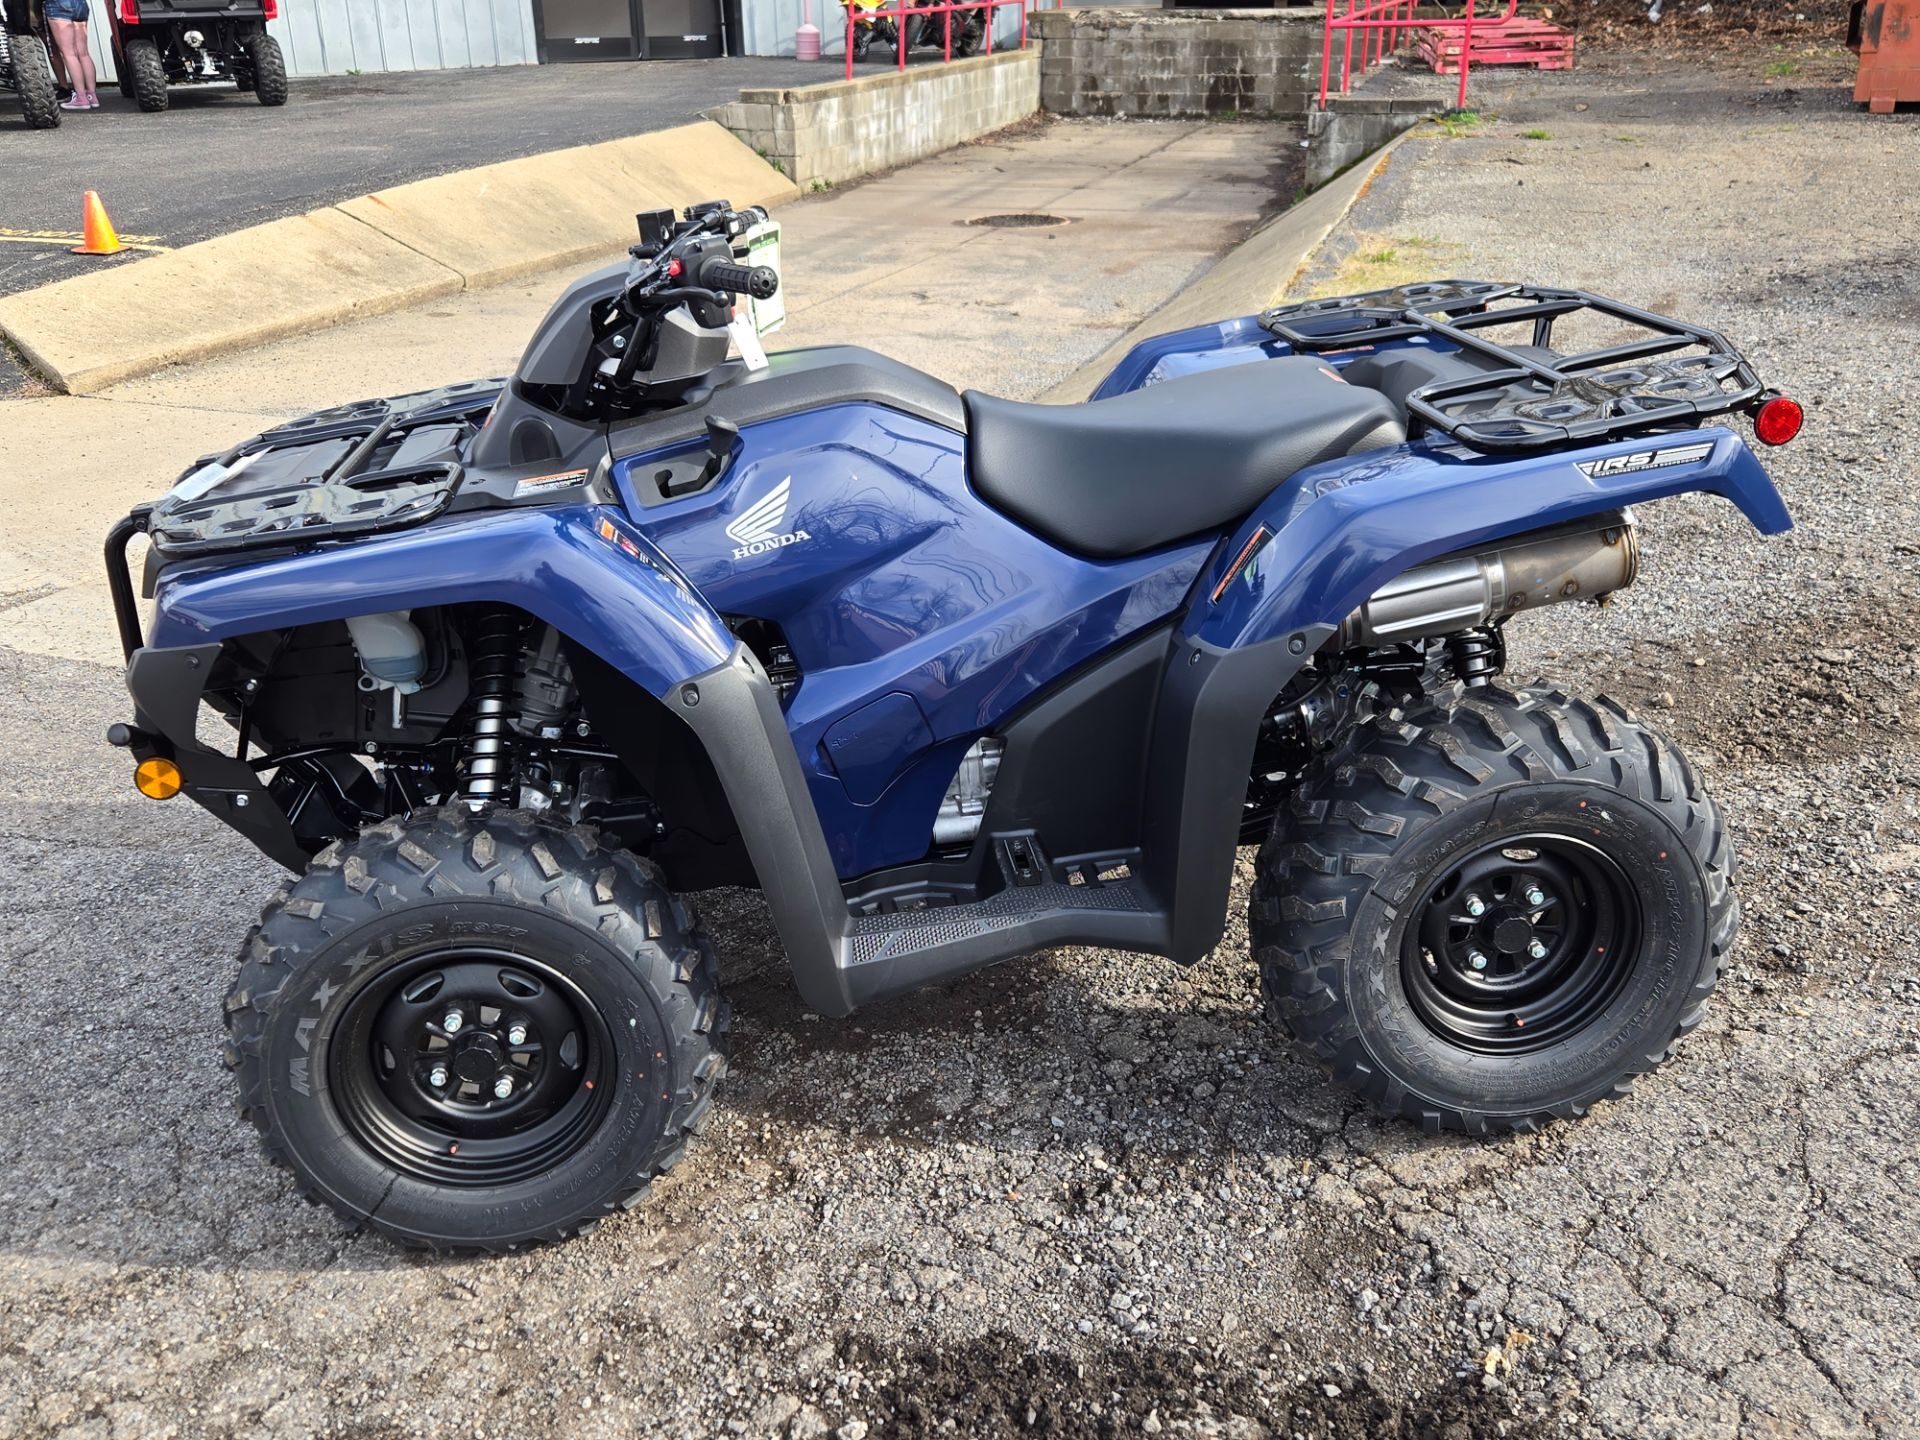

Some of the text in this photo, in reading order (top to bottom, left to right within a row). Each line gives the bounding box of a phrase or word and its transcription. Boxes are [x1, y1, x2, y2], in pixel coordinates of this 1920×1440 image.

[1594, 452, 1653, 472] IRS
[731, 530, 812, 560] HONDA
[289, 923, 434, 1097] MAXXIS
[1370, 871, 1434, 1065] MAXXIS
